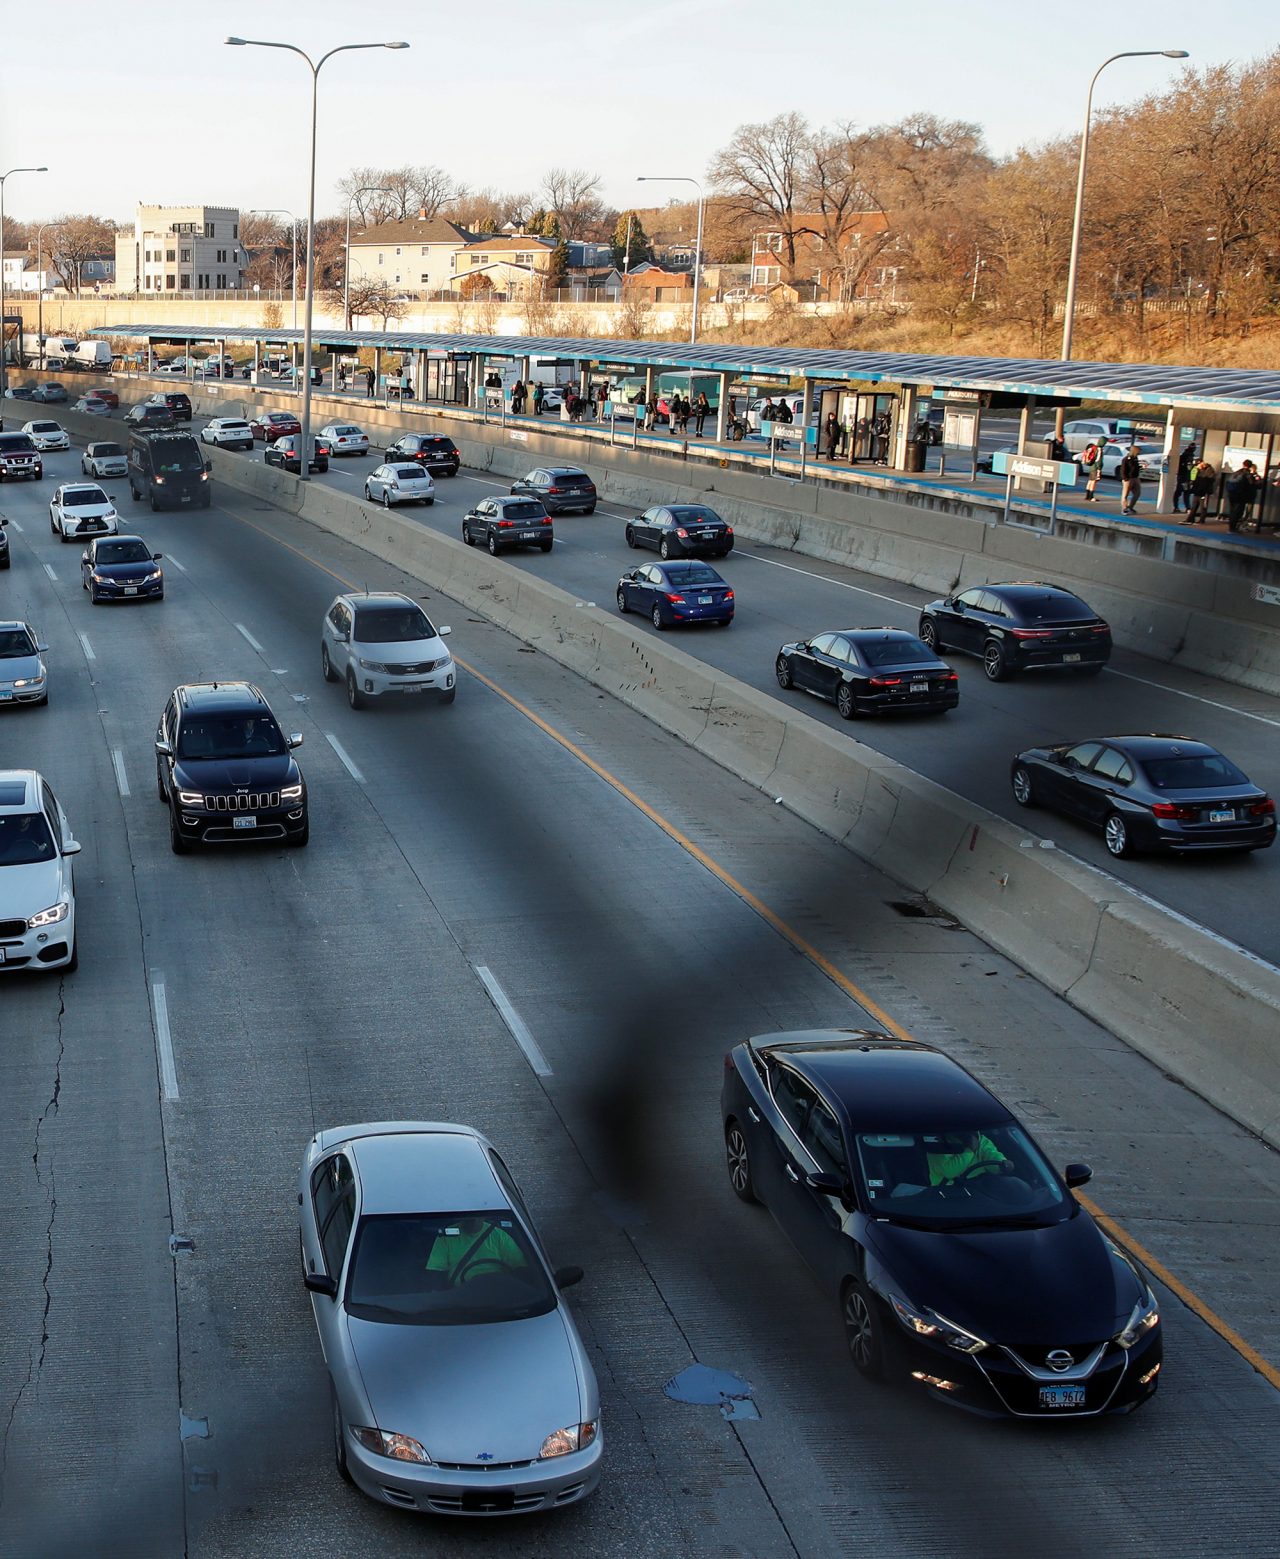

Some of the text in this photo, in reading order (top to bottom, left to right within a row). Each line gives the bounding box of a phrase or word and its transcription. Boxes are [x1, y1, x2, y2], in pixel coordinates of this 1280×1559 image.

[773, 425, 795, 437] Addison
[1011, 460, 1042, 476] Addison
[1063, 1391, 1084, 1402] 9672
